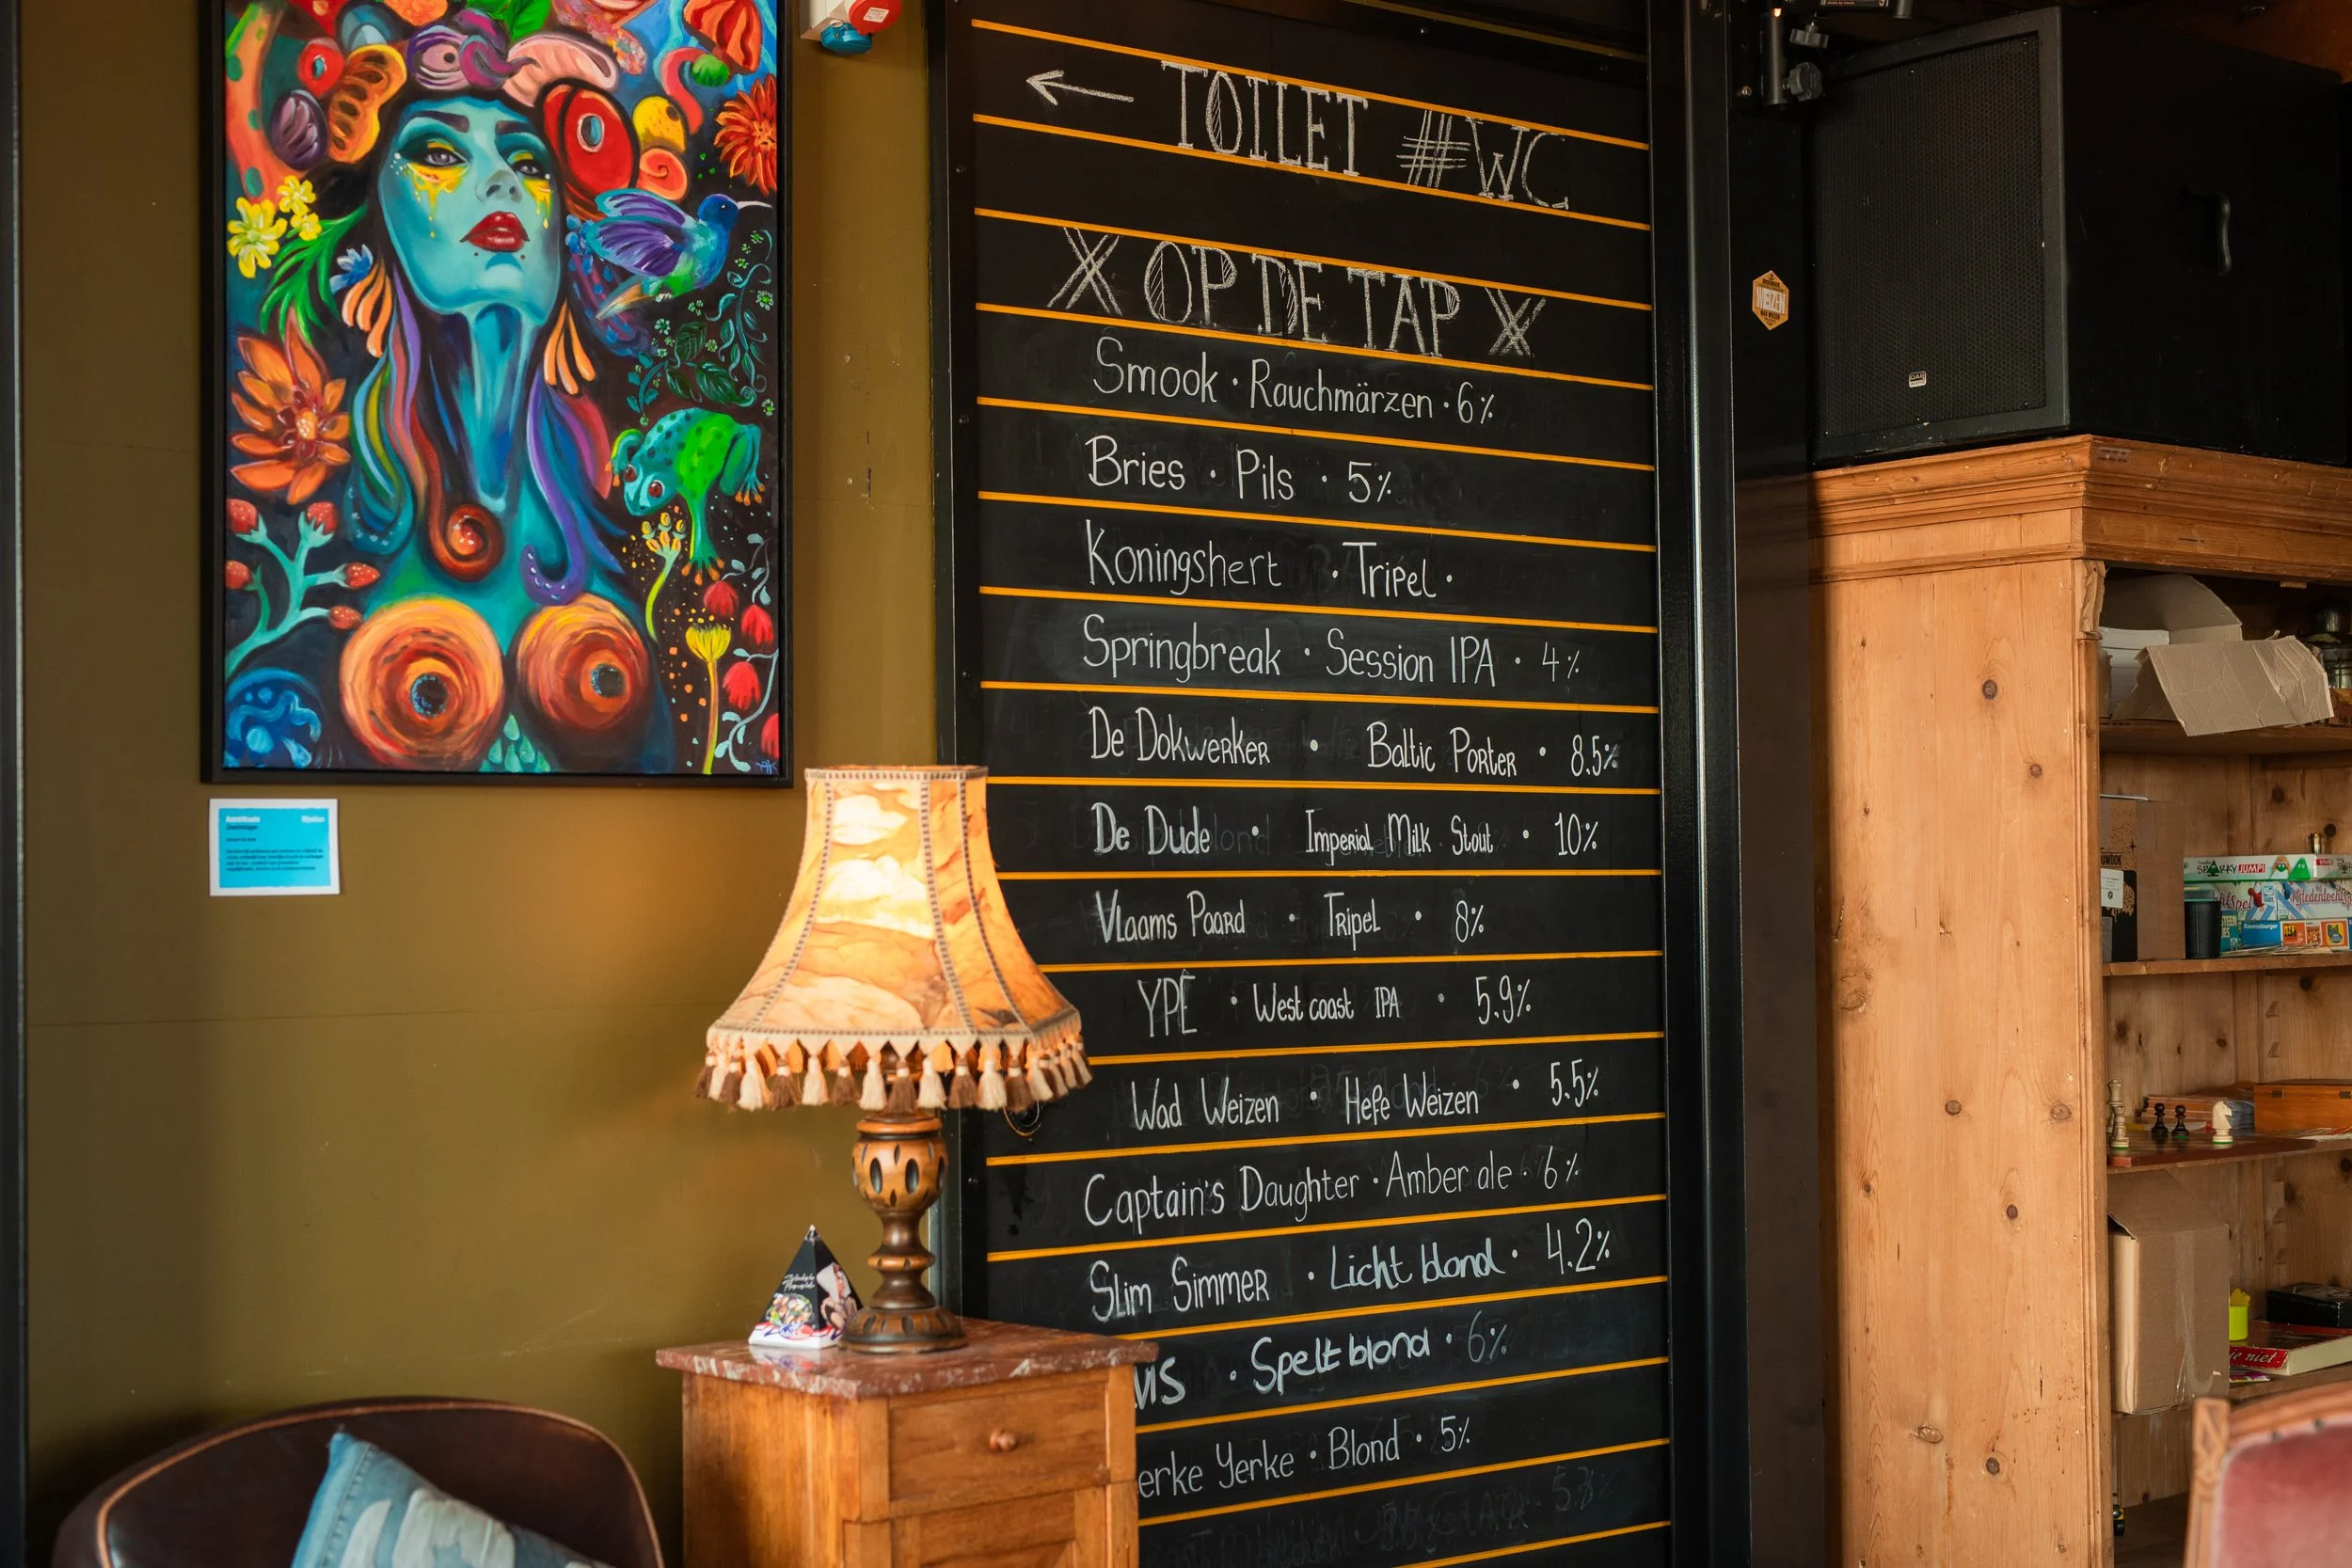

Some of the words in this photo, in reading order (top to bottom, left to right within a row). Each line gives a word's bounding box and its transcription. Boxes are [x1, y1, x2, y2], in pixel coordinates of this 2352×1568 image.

[1161, 60, 1368, 177] TOILET
[1142, 240, 1236, 327] OP
[1249, 253, 1327, 343] DE
[1346, 268, 1462, 358] TAP
[1092, 336, 1218, 403] Smook
[1249, 358, 1433, 419] Rauchmärzen
[1456, 381, 1495, 425] 6%
[1085, 435, 1186, 490] Bries
[1235, 448, 1295, 501] Pils
[1347, 461, 1391, 503] 5%
[1085, 519, 1281, 595] Koningshert
[1342, 541, 1437, 598] Tripel
[1082, 613, 1281, 683] Springbreak
[1325, 627, 1434, 683] Session
[1450, 635, 1497, 688] IPA
[1541, 641, 1581, 683] 4%
[1088, 705, 1125, 760] De
[1366, 721, 1436, 772] Baltic
[1569, 734, 1620, 778] 8.5%
[1089, 801, 1130, 857] De
[1143, 803, 1211, 856] Dude
[1387, 812, 1432, 857] Milk
[1450, 814, 1494, 855] Stout
[1556, 811, 1598, 857] 10%
[1186, 890, 1246, 941] Paard
[1324, 891, 1381, 952] Tripel
[1454, 899, 1485, 943] 8%
[1136, 971, 1197, 1037] YPE
[1252, 982, 1305, 1023] West
[1309, 987, 1355, 1022] coast
[1374, 985, 1402, 1020] IPA
[1473, 975, 1533, 1025] 5.9%
[1129, 1077, 1183, 1132] Wad
[1200, 1075, 1279, 1126] Weizen
[1402, 1070, 1480, 1119] Weizen
[1549, 1058, 1600, 1108] 5.5%
[1083, 1172, 1225, 1235] Captain's
[1238, 1164, 1360, 1223] Daughter
[1385, 1149, 1469, 1199] Amber
[1476, 1149, 1513, 1191] ale
[1542, 1145, 1580, 1191] 6%
[1089, 1259, 1152, 1323] Slim
[1328, 1244, 1413, 1292] Licht
[1421, 1238, 1506, 1284] blond
[1545, 1217, 1611, 1276] 4.2%
[1250, 1336, 1343, 1396] Spelt
[1347, 1327, 1431, 1370] blond
[1468, 1309, 1508, 1364] 6%
[1215, 1445, 1295, 1490] Yerke
[1327, 1418, 1400, 1470] Blond
[1439, 1415, 1470, 1452] 5%
